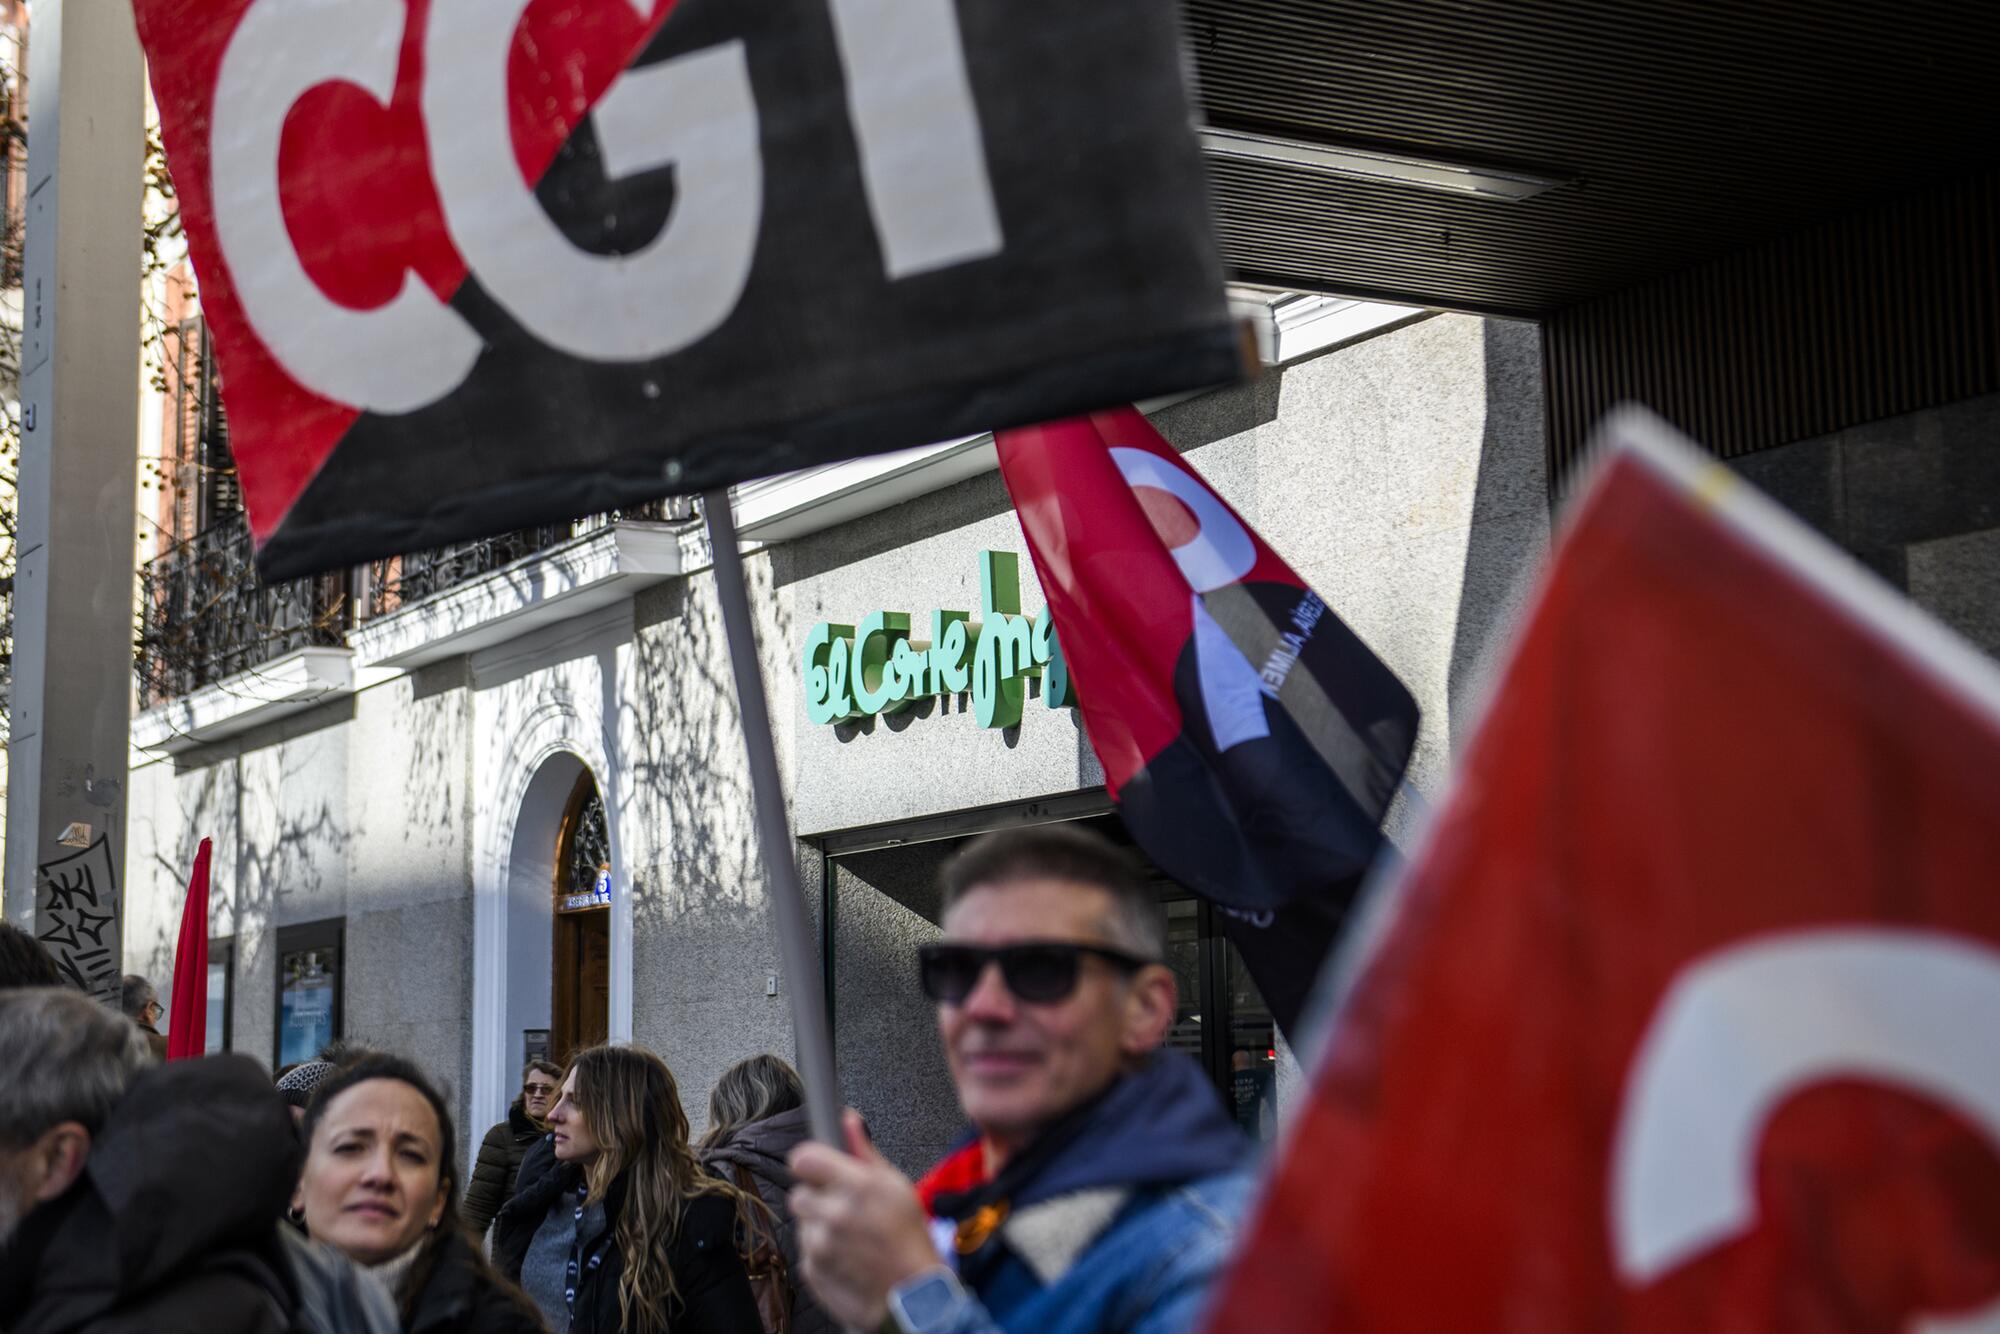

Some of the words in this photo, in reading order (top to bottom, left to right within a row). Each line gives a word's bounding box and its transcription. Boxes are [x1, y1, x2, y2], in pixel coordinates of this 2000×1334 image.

[803, 622, 852, 725] El
[852, 610, 970, 714] Corte
[972, 550, 1069, 729] Ing
